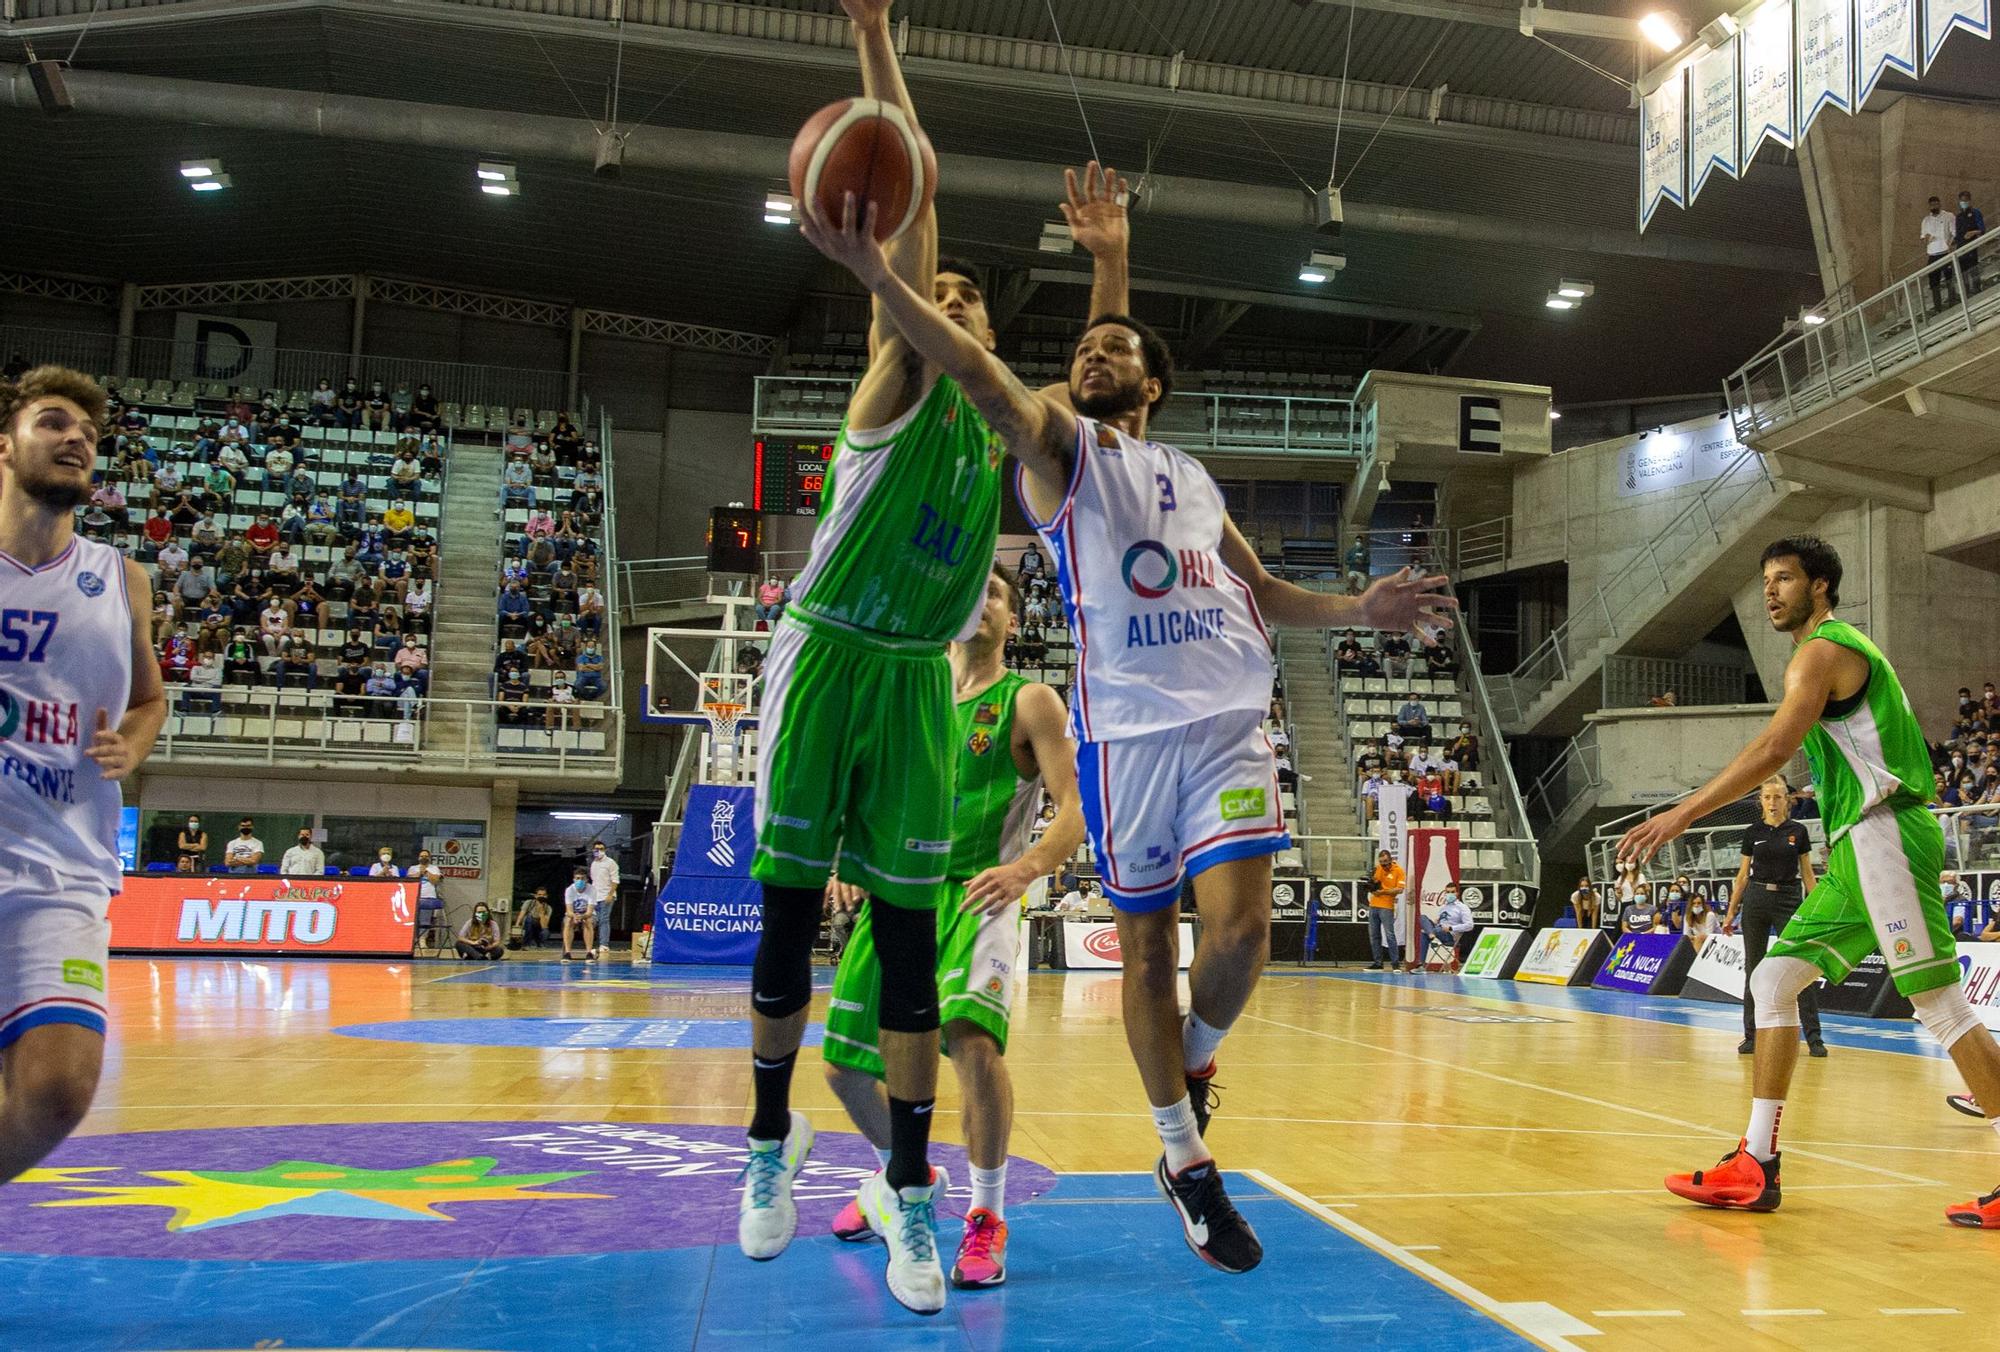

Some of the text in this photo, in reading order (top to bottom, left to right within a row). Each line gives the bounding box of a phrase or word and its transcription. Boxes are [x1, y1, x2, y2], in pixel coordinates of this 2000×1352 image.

[1646, 131, 1661, 151] LEB
[193, 320, 253, 380] D
[1459, 397, 1501, 453] E
[798, 464, 825, 472] LOCAL
[1155, 473, 1177, 513] 3
[737, 531, 748, 548] 7
[911, 502, 973, 567] TAU
[1178, 549, 1216, 588] HLA
[0, 608, 59, 663] 57
[1127, 608, 1228, 648] ALICANTE
[25, 700, 78, 746] HLA
[430, 855, 480, 866] FRIDAYS
[1129, 860, 1163, 873] Suma
[177, 898, 338, 945] MITO
[664, 917, 764, 933] VALENCIANA
[1629, 914, 1652, 923] Coke
[1885, 919, 1908, 933] TAU
[1621, 953, 1632, 968] LA
[1965, 966, 2000, 1006] HLA
